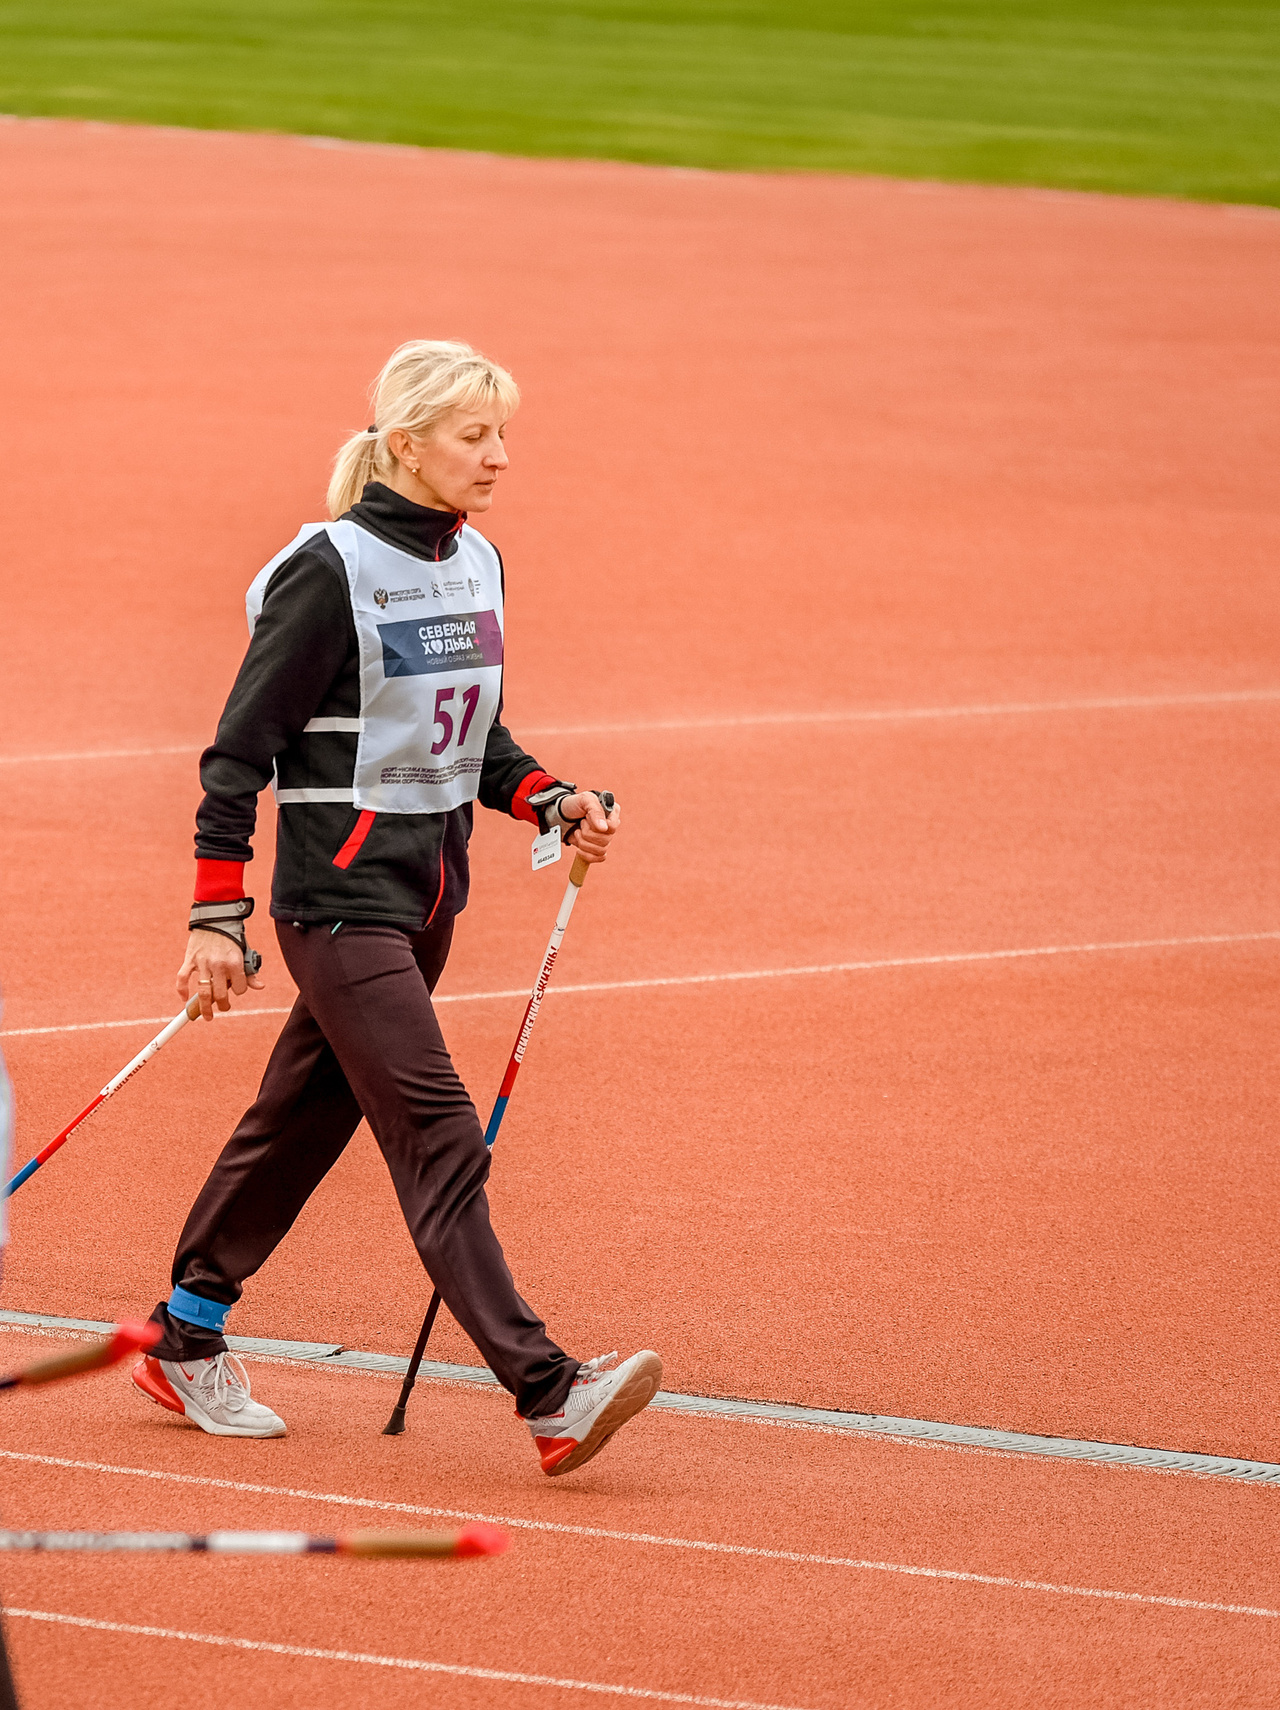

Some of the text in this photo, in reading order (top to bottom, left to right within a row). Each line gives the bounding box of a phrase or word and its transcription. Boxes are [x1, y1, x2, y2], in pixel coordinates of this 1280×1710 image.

[418, 620, 476, 640] СЕВЕРНАЯ
[430, 684, 480, 755] 51
[537, 945, 559, 993] ЖИЗНЬ!
